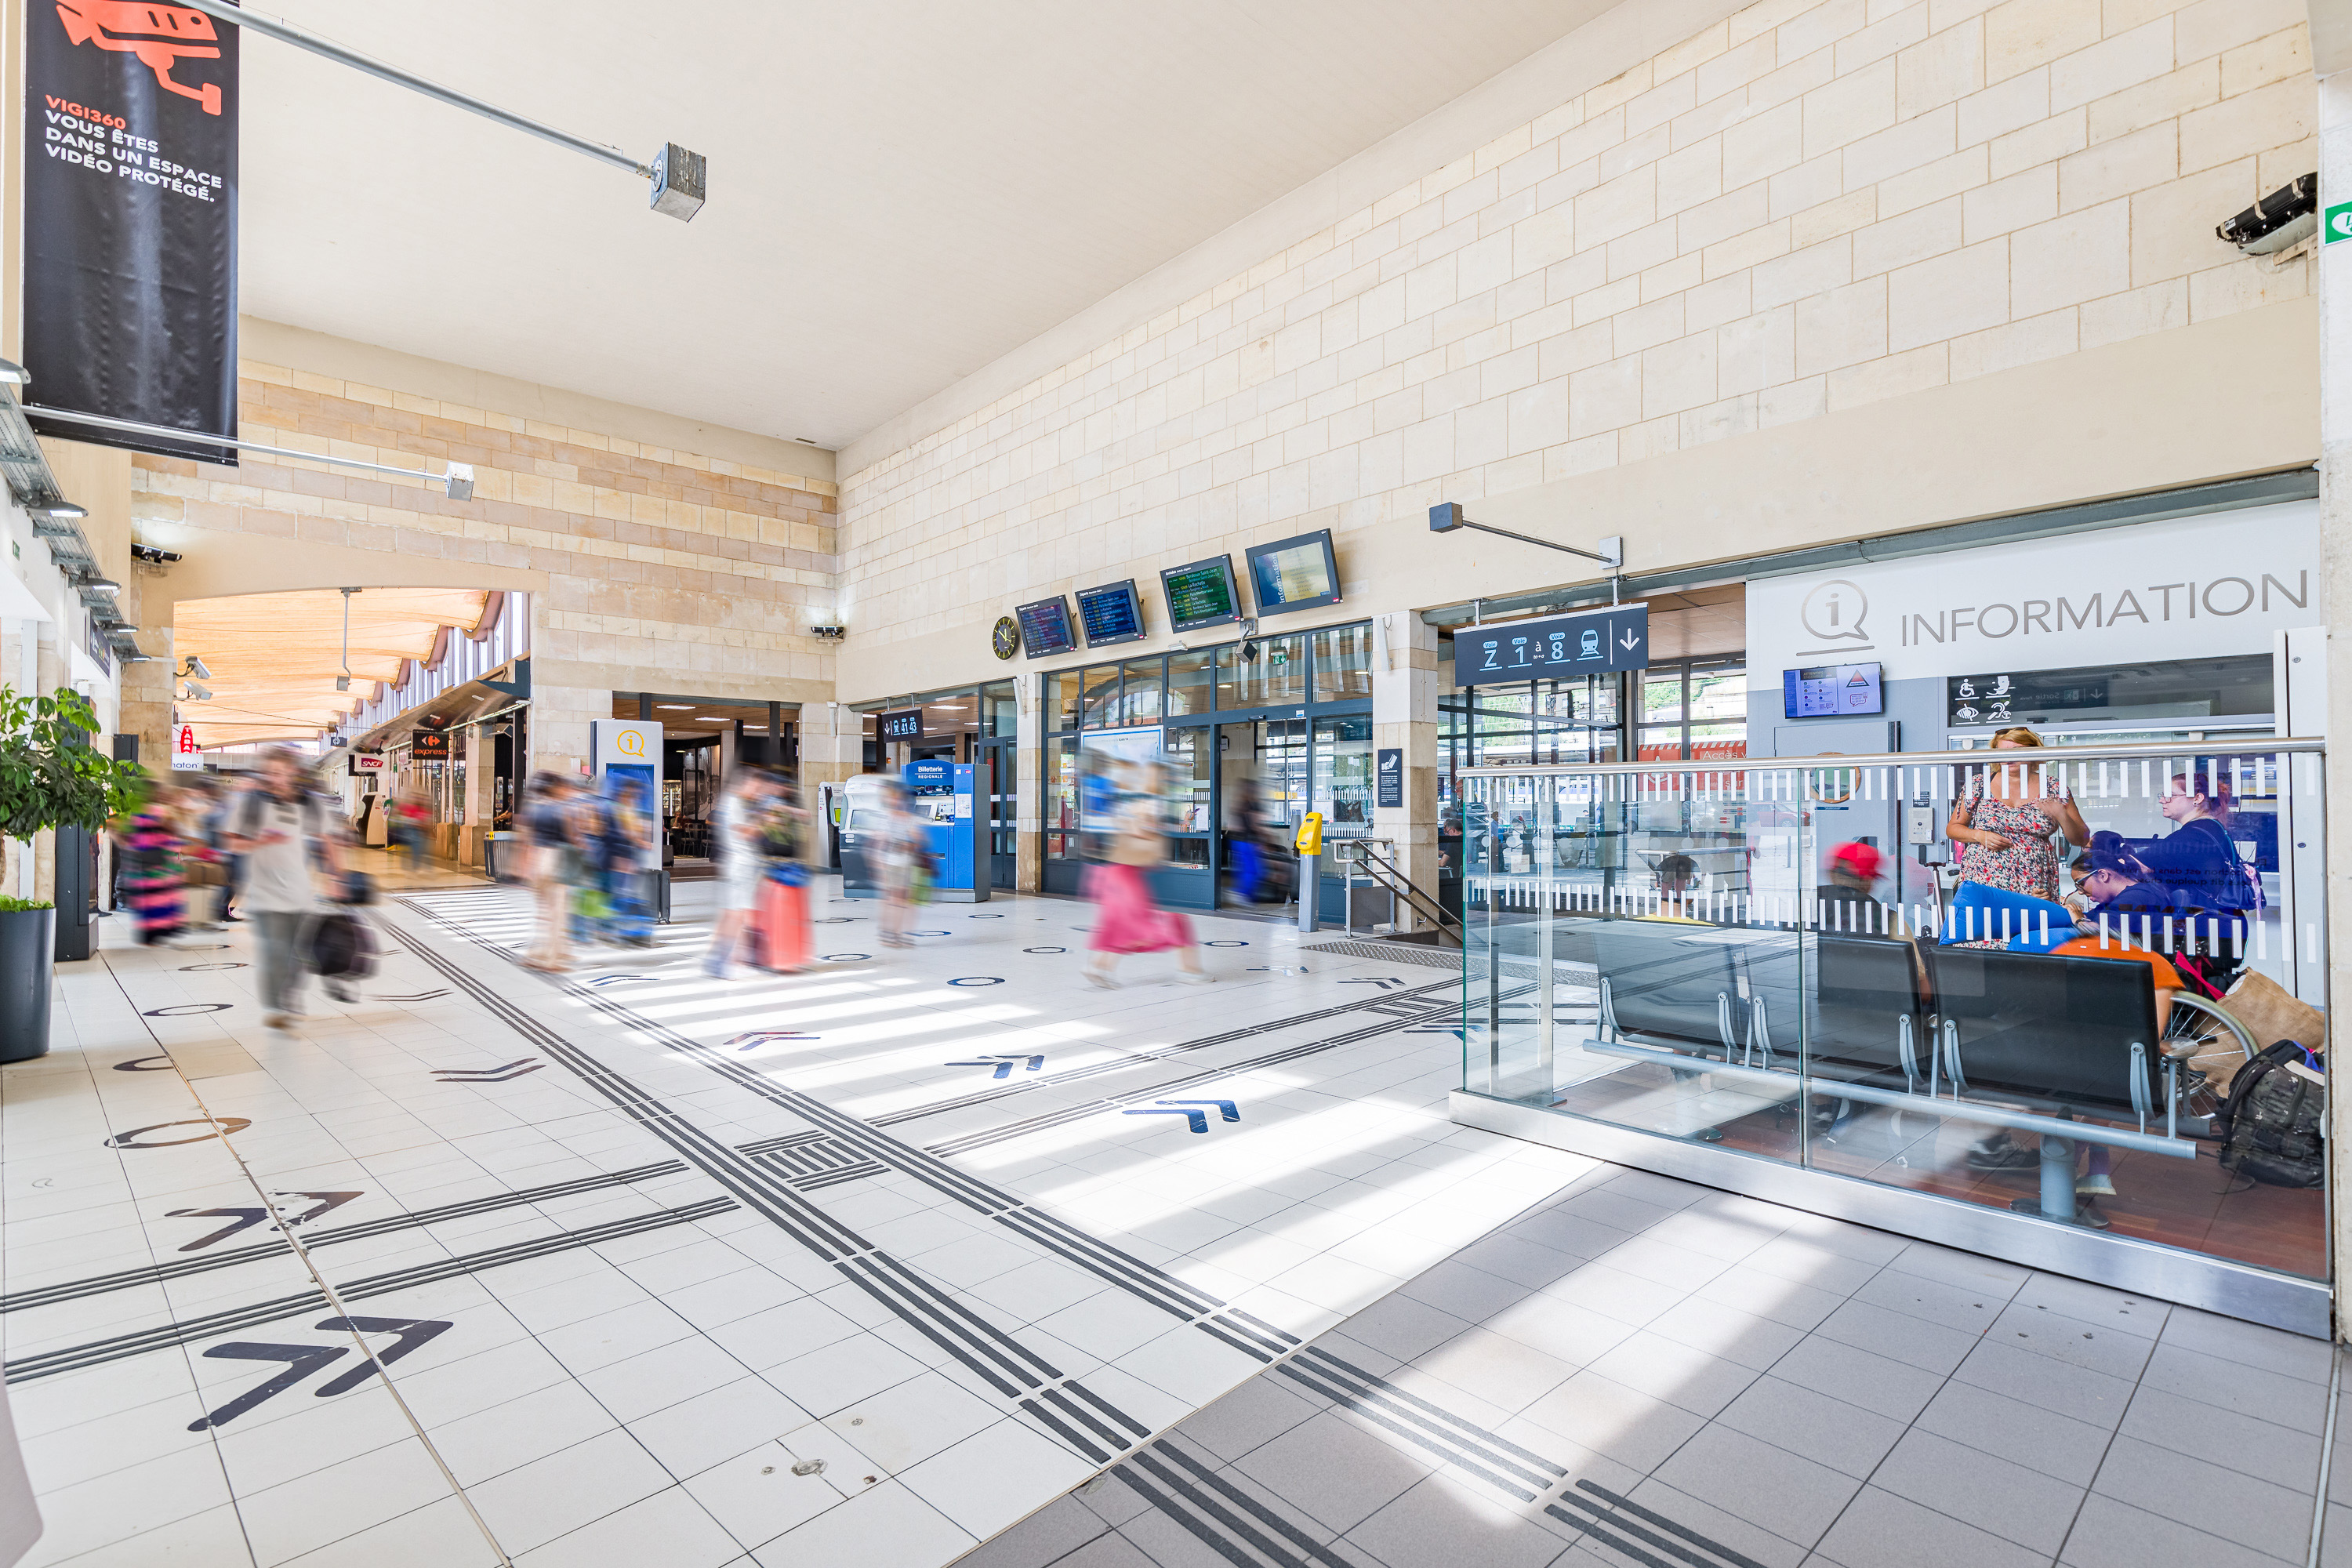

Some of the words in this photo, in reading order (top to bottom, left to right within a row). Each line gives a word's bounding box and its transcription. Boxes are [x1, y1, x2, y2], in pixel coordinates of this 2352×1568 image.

[45, 94, 126, 130] VIGI360
[45, 109, 105, 139] VOUS
[111, 129, 158, 153] ÊTES
[45, 126, 106, 155] DANS
[112, 147, 143, 165] UN
[149, 156, 222, 189] ESPACE
[45, 143, 113, 173] VIDÉO
[118, 165, 215, 202] PROTÉGÉ.
[1272, 553, 1286, 604] information
[1901, 569, 2307, 647] INFORMATION
[1484, 649, 1497, 667] Z
[1515, 645, 1524, 664] 1
[1535, 641, 1542, 652] à
[1551, 641, 1563, 660] 8
[901, 722, 908, 733] 41
[909, 721, 917, 731] 43
[1702, 750, 1738, 760] Accès
